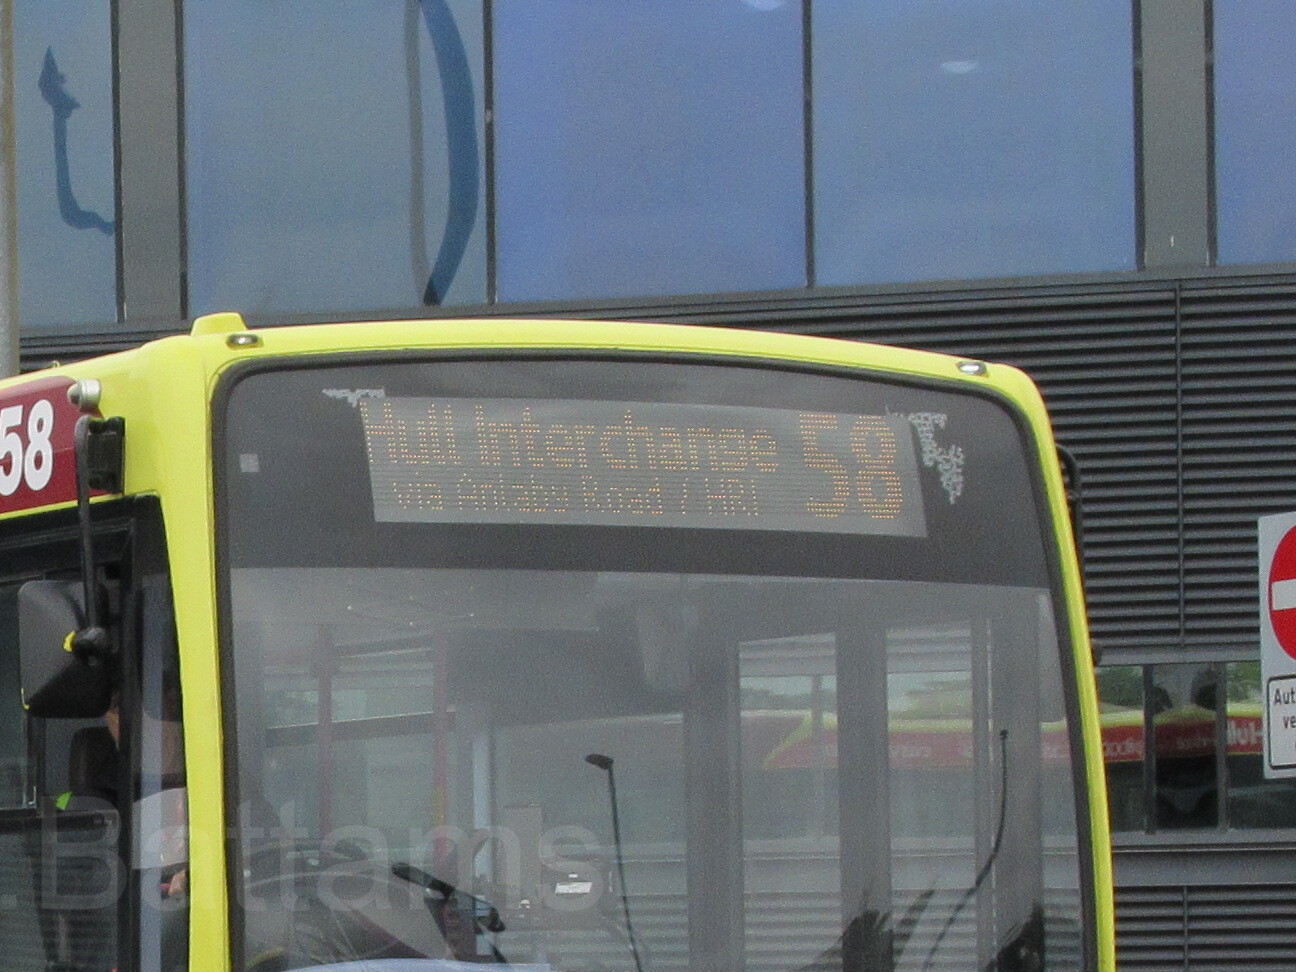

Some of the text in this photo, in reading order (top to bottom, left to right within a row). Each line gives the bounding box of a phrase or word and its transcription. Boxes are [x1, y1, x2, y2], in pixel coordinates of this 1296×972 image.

[359, 401, 903, 519] Hull Interchange 58
[581, 474, 662, 514] Road
